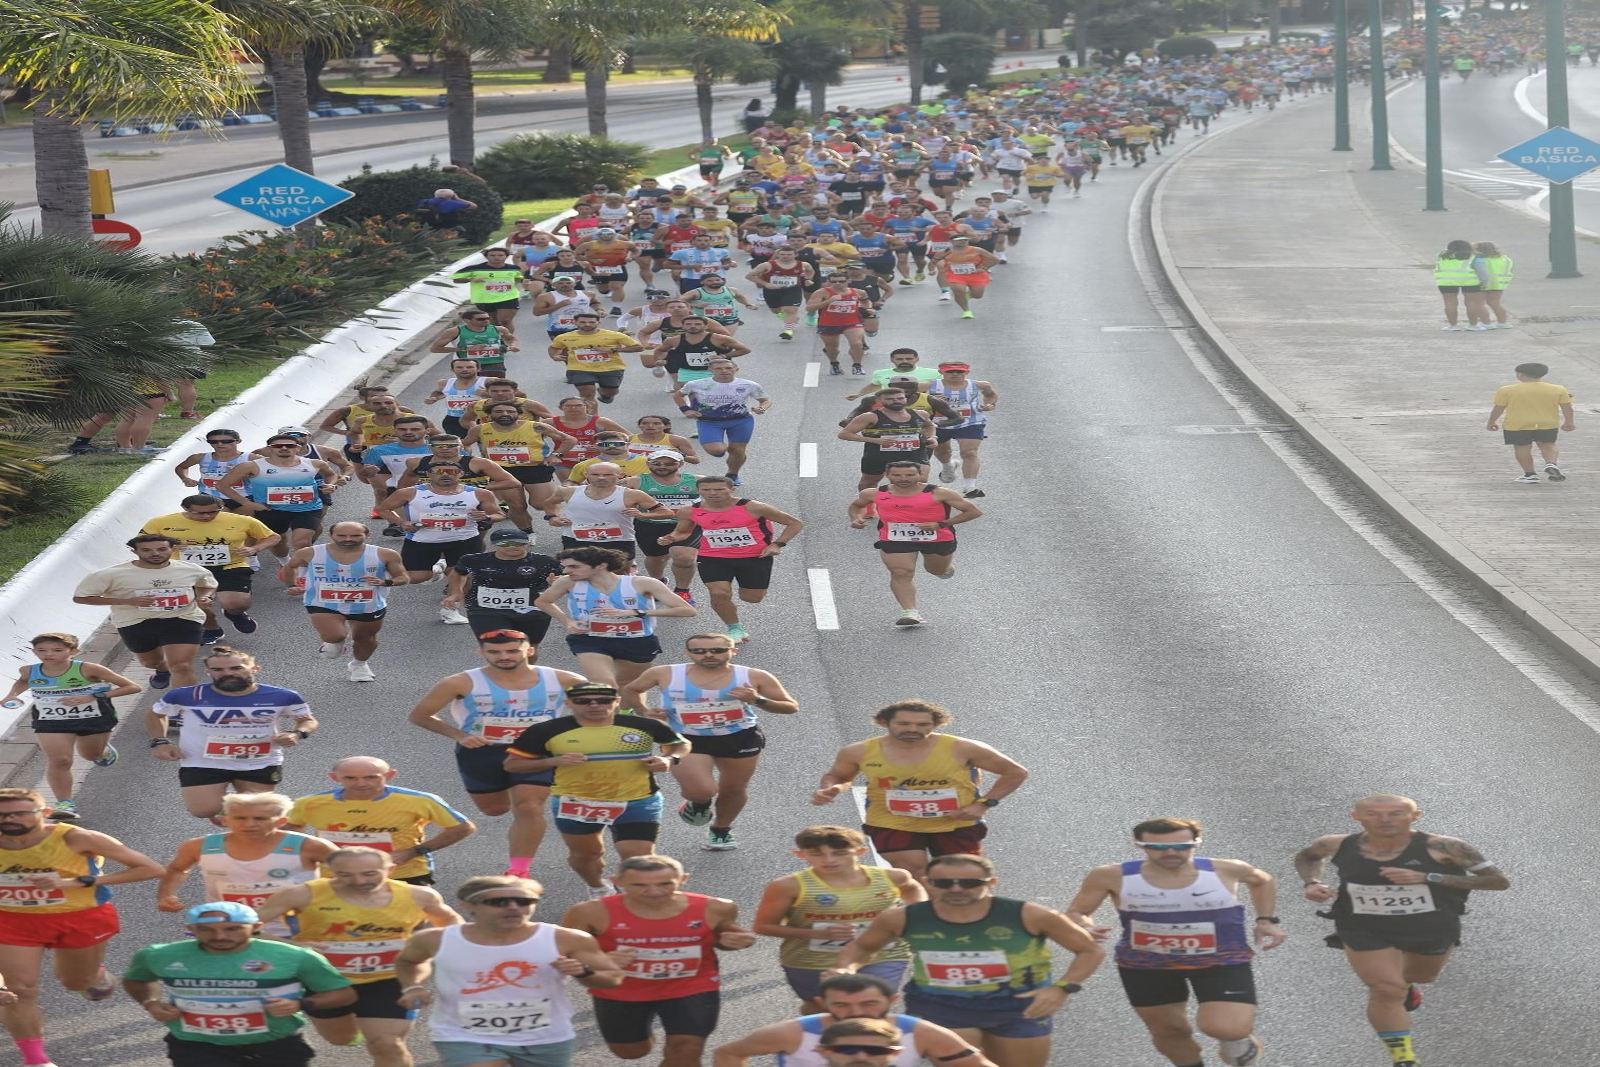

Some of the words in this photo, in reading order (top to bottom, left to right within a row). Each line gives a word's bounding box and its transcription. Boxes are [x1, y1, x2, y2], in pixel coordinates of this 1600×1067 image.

[1538, 146, 1579, 155] RED
[1520, 155, 1597, 163] BASICA
[259, 186, 305, 196] RED
[240, 195, 326, 206] BASICA
[587, 530, 609, 538] 84
[709, 534, 752, 543] 11948
[184, 552, 228, 561] 7122
[331, 592, 364, 600] 174
[482, 596, 525, 605] 2046
[606, 624, 630, 633] 29
[43, 705, 95, 716] 2044
[191, 709, 276, 724] VAS
[699, 713, 727, 724] 35
[219, 745, 261, 755] 139
[573, 805, 611, 819] 173
[908, 802, 940, 813] 38
[0, 888, 50, 901] 200
[1355, 896, 1427, 907] 11281
[1145, 936, 1201, 949] 230
[345, 955, 382, 968] 40
[632, 961, 686, 974] 189
[946, 967, 985, 980] 88
[173, 979, 258, 988] ATLETISMO
[193, 1016, 251, 1030] 138
[470, 1012, 544, 1028] 2077
